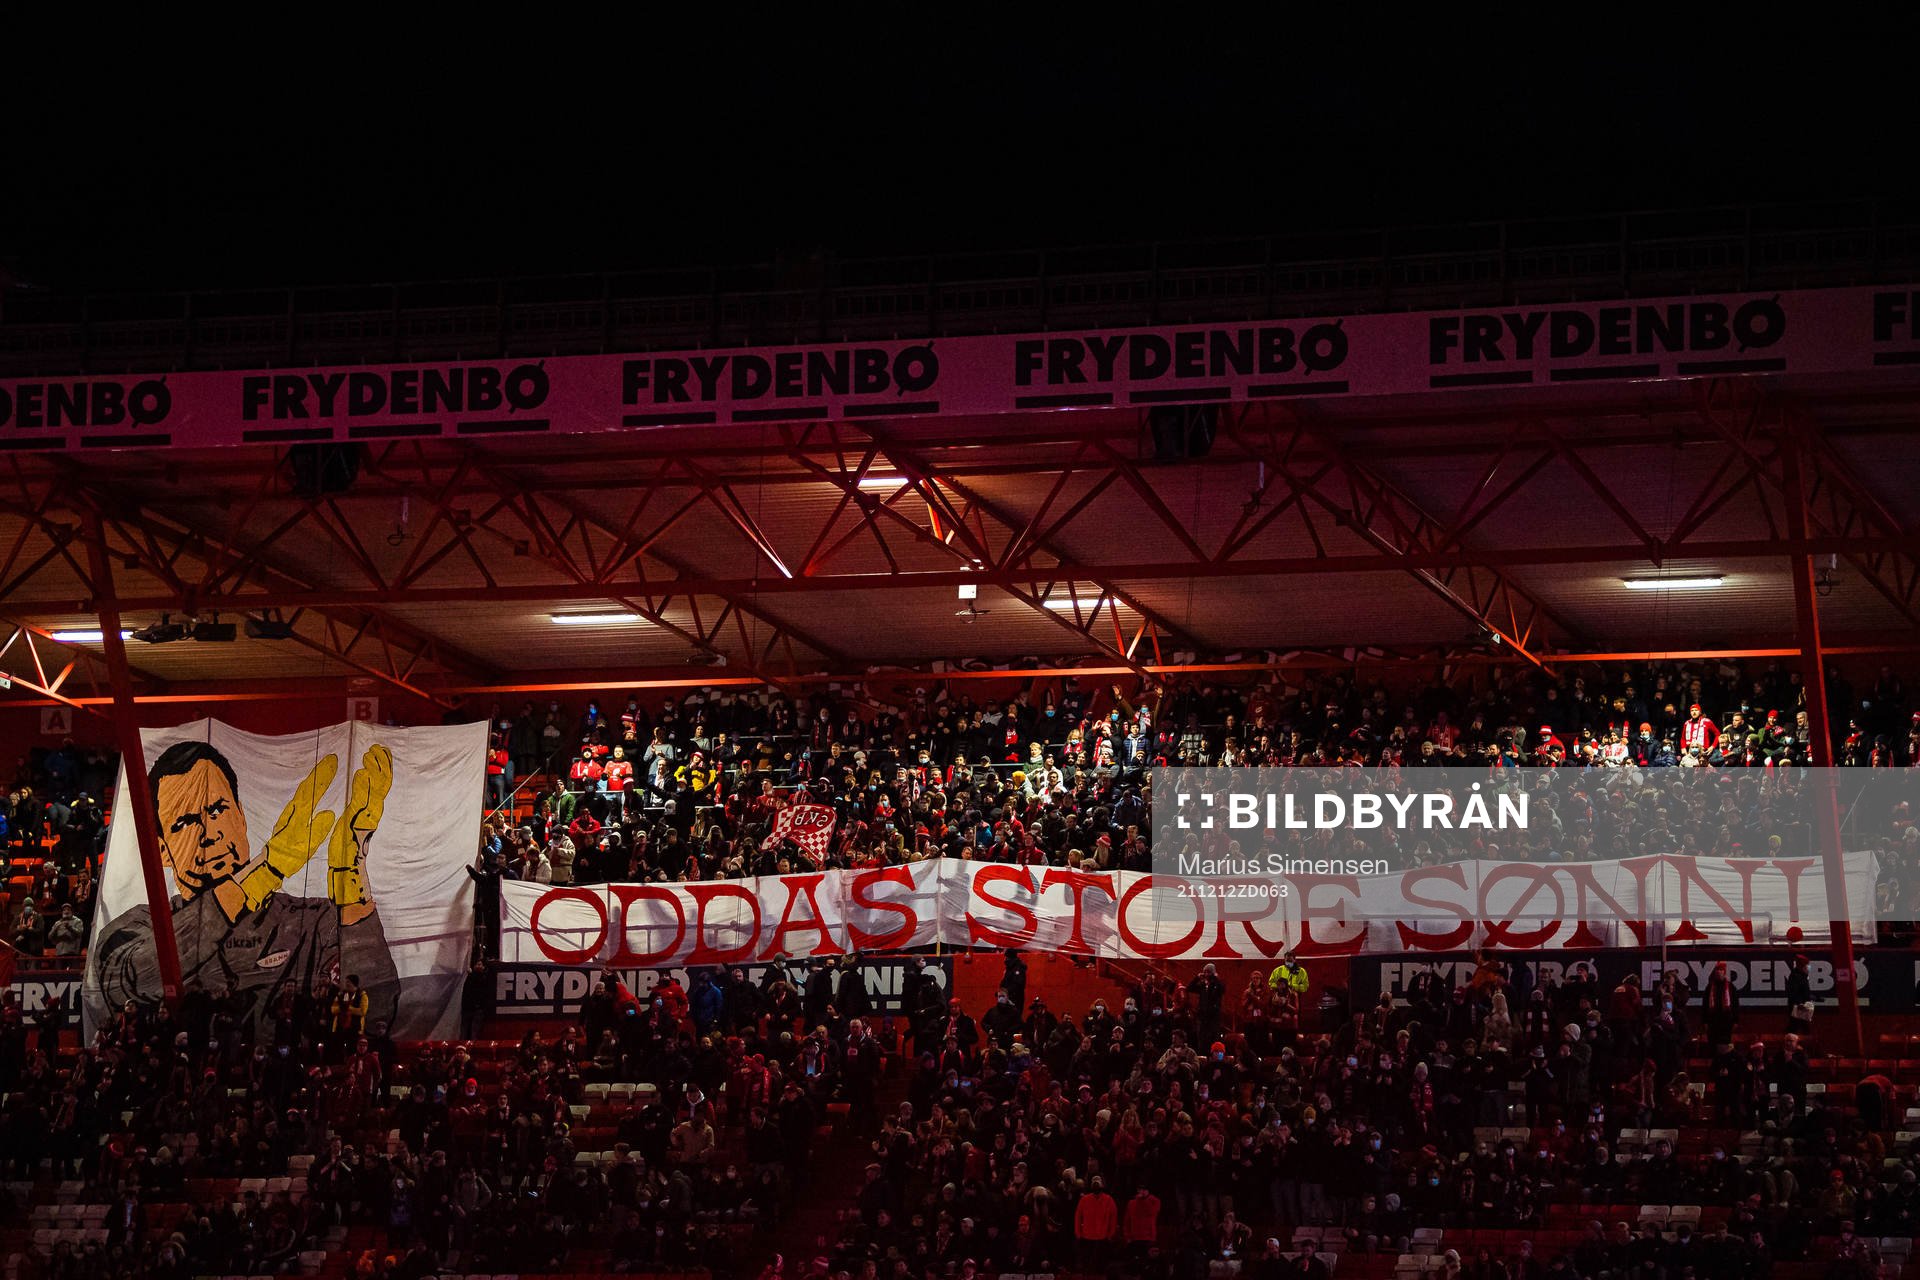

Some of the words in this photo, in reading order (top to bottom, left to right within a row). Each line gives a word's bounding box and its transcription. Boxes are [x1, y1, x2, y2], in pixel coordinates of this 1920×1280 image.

[1016, 318, 1348, 386] FRYDENBØ
[1430, 294, 1786, 365] FRYDENBØ
[243, 360, 549, 420] FRYDENBØ
[623, 341, 939, 404] FRYDENBØ
[48, 710, 66, 730] A
[355, 701, 371, 720] B
[530, 864, 918, 966] ODDAS
[965, 864, 1368, 958] STORE
[1396, 855, 1815, 951] SØNN!
